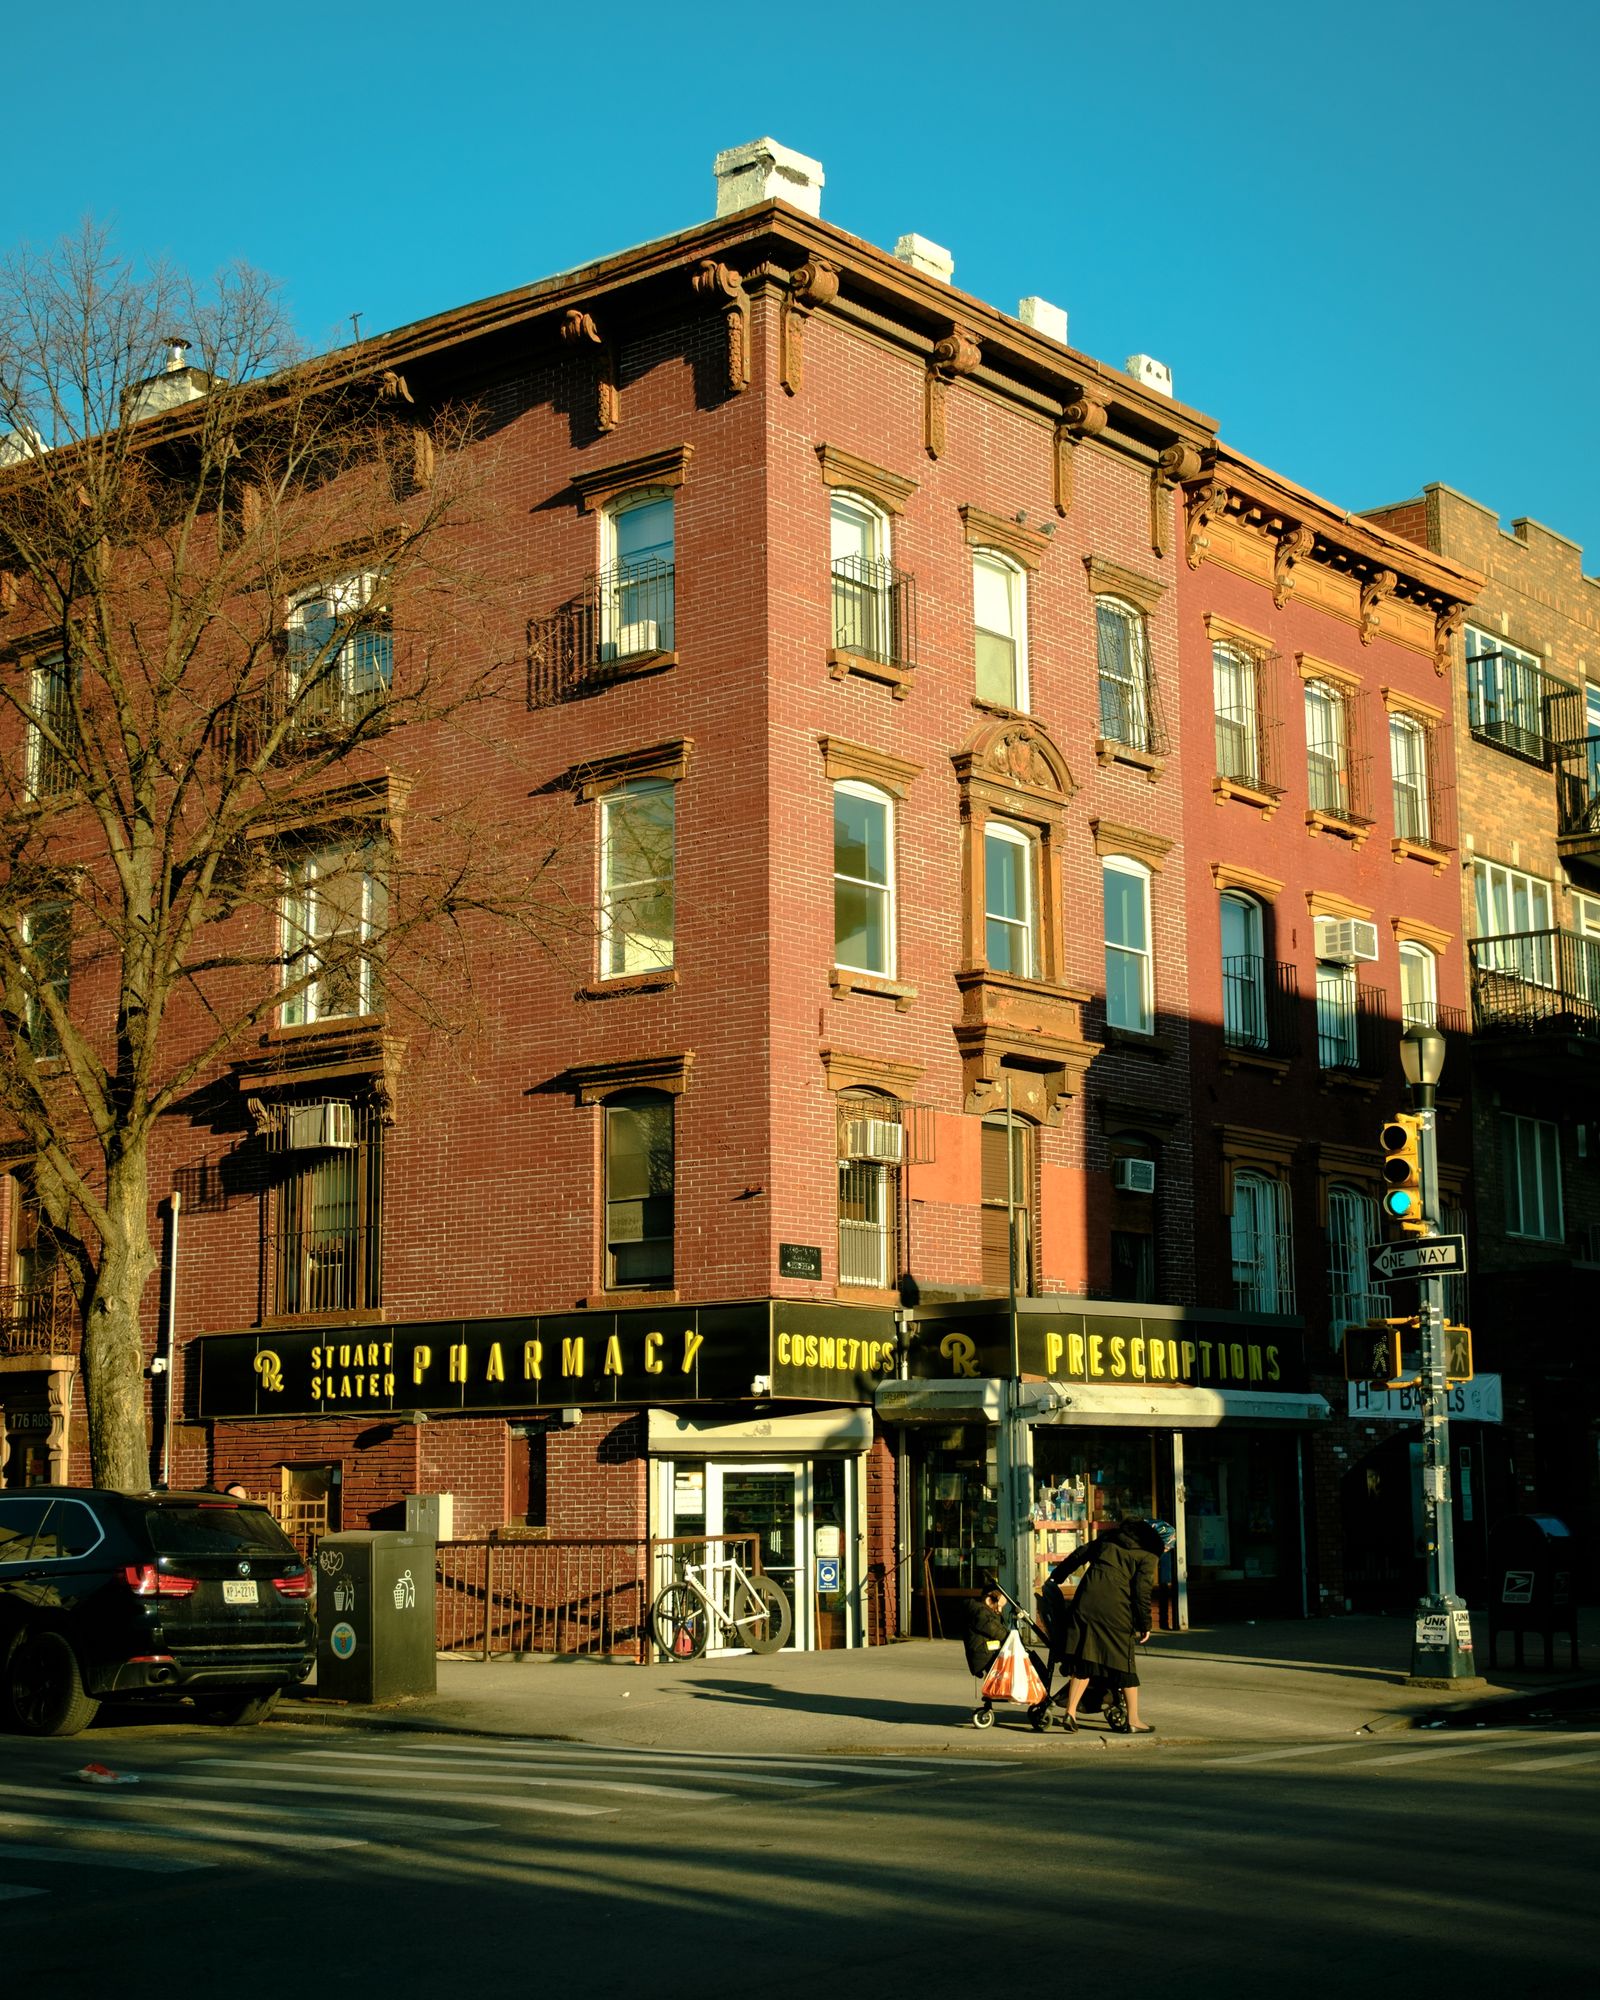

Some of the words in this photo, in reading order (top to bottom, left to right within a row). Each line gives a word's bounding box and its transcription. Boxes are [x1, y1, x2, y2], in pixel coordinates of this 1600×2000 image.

[1381, 1252, 1406, 1269] ONE
[1416, 1247, 1448, 1263] WAY
[311, 1342, 393, 1370] STUART
[413, 1330, 704, 1385] PHARMACY
[778, 1332, 895, 1373] COSMETICS
[1045, 1332, 1281, 1381] PRESCRIPTIONS
[311, 1373, 395, 1400] SLATER
[1400, 1386, 1465, 1413] BALS
[11, 1413, 30, 1428] 176
[32, 1413, 52, 1428] ROS
